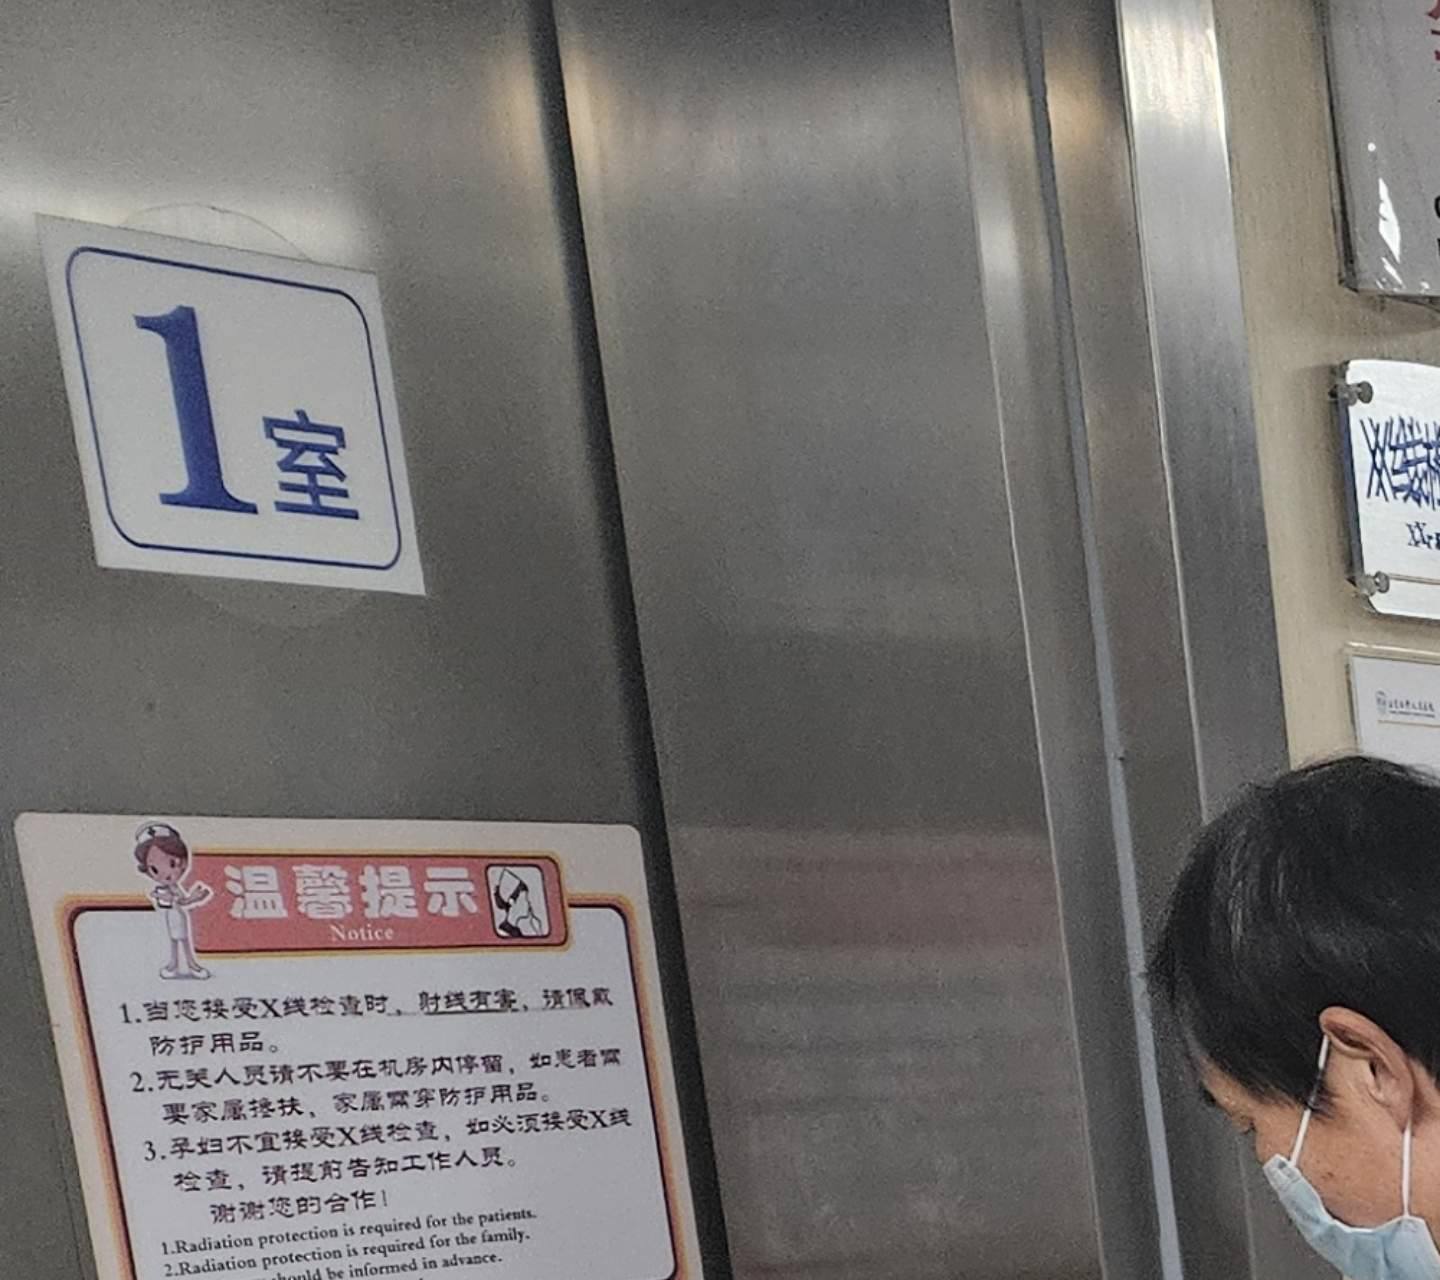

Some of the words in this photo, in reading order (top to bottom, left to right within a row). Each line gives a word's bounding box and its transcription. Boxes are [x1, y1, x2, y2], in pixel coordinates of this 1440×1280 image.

[223, 863, 479, 919] 温馨提示
[330, 923, 395, 943] Notice
[161, 1236, 254, 1256] 1.Radiation
[257, 1225, 339, 1250] protection
[343, 1223, 356, 1238] is
[359, 1216, 423, 1240] required
[425, 1213, 448, 1230] for
[451, 1211, 474, 1227] the
[477, 1206, 537, 1229] patients.
[164, 1256, 258, 1279] 2.Radiation
[261, 1246, 343, 1272] protection
[346, 1243, 359, 1258] is
[362, 1237, 426, 1262] required
[428, 1234, 451, 1250] for
[454, 1232, 477, 1248] the
[481, 1228, 531, 1248] family.
[348, 1260, 418, 1278] informed
[421, 1257, 438, 1272] in
[441, 1251, 503, 1269] advance.
